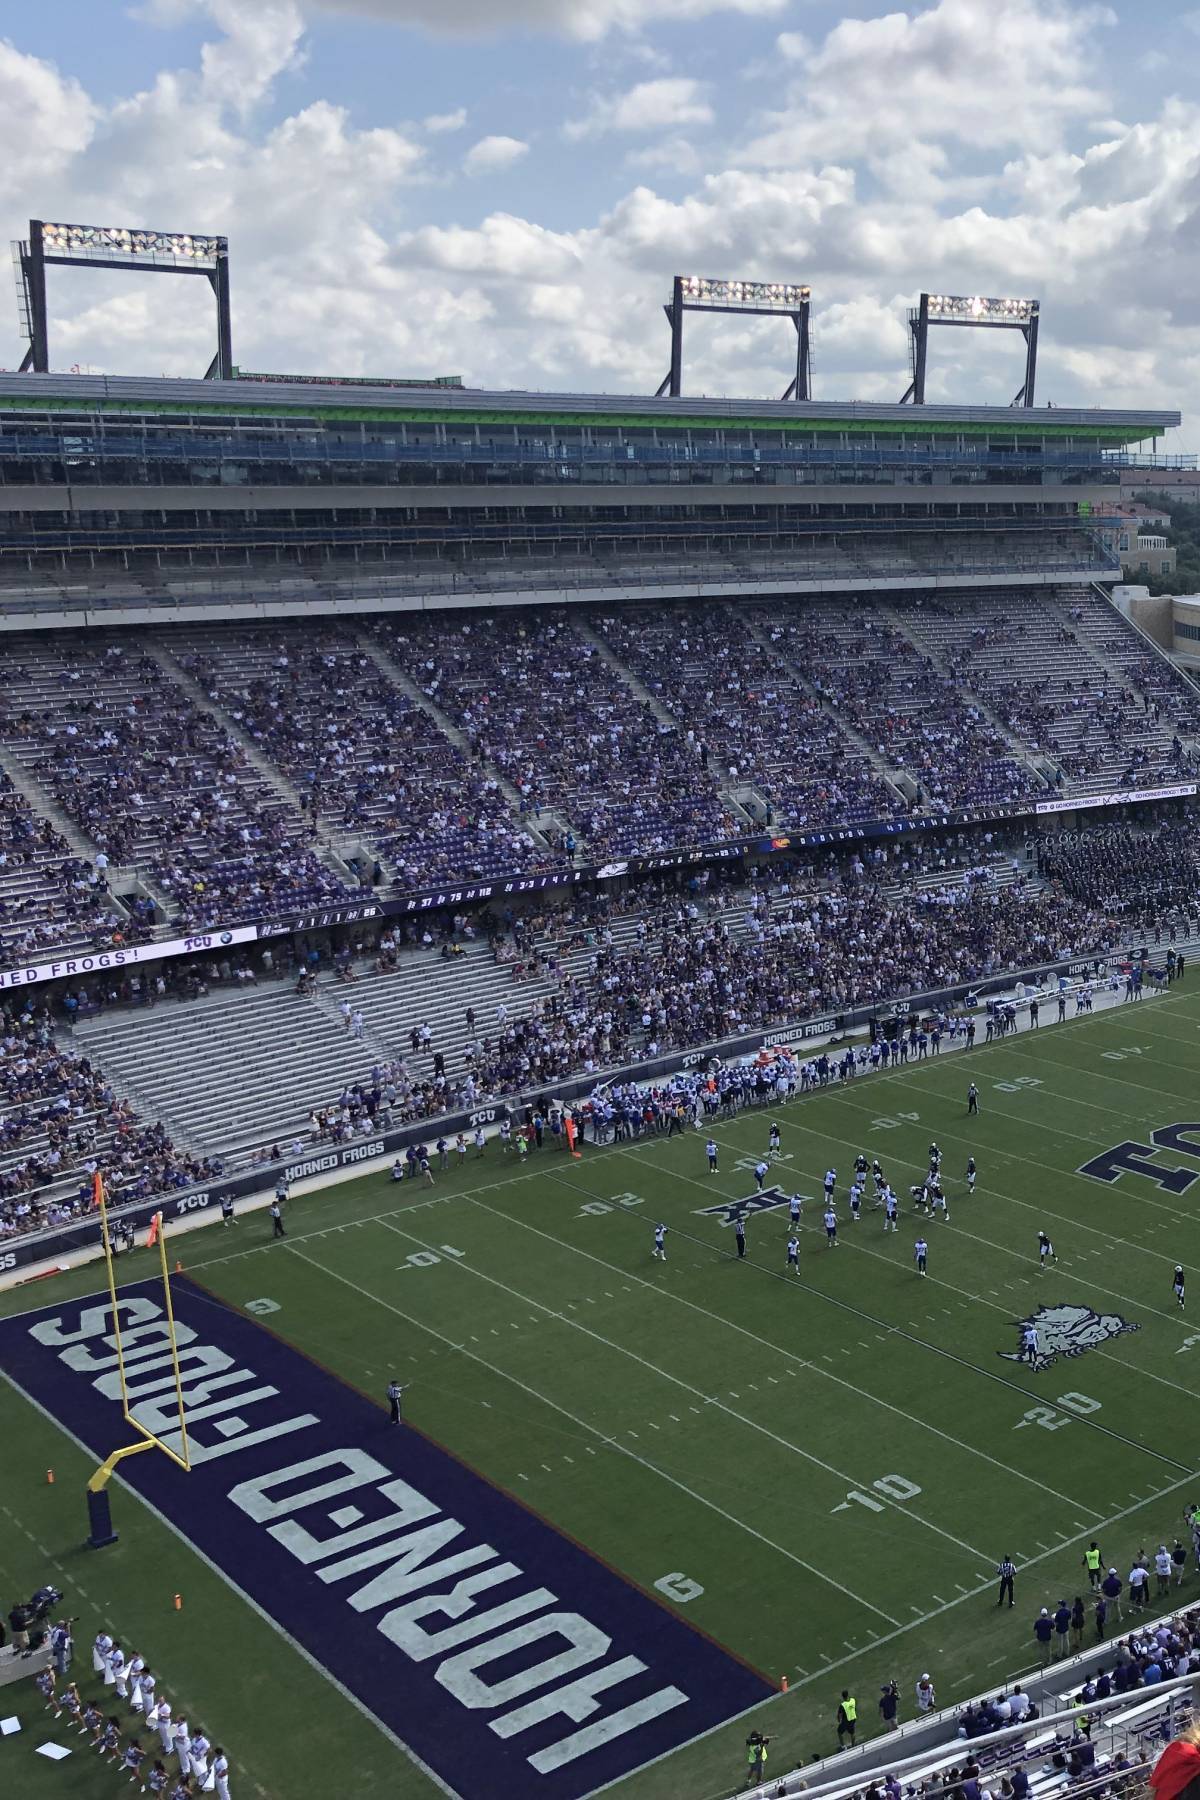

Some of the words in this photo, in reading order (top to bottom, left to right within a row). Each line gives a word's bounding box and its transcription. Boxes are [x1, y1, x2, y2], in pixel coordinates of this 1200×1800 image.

[363, 908, 376, 917] 26
[184, 936, 212, 952] TCU
[1069, 961, 1096, 975] HORNE
[764, 1028, 802, 1048] HORNED
[805, 1019, 837, 1037] FROGS
[993, 1076, 1045, 1093] 50
[470, 1108, 497, 1128] TCU
[285, 1153, 340, 1181] HORNED
[342, 1141, 385, 1166] FROGS
[177, 1193, 209, 1215] TCU
[28, 1297, 321, 1466] FROGS
[1023, 1391, 1103, 1431] 20
[843, 1472, 923, 1513] 10
[227, 1448, 690, 1775] HORNED
